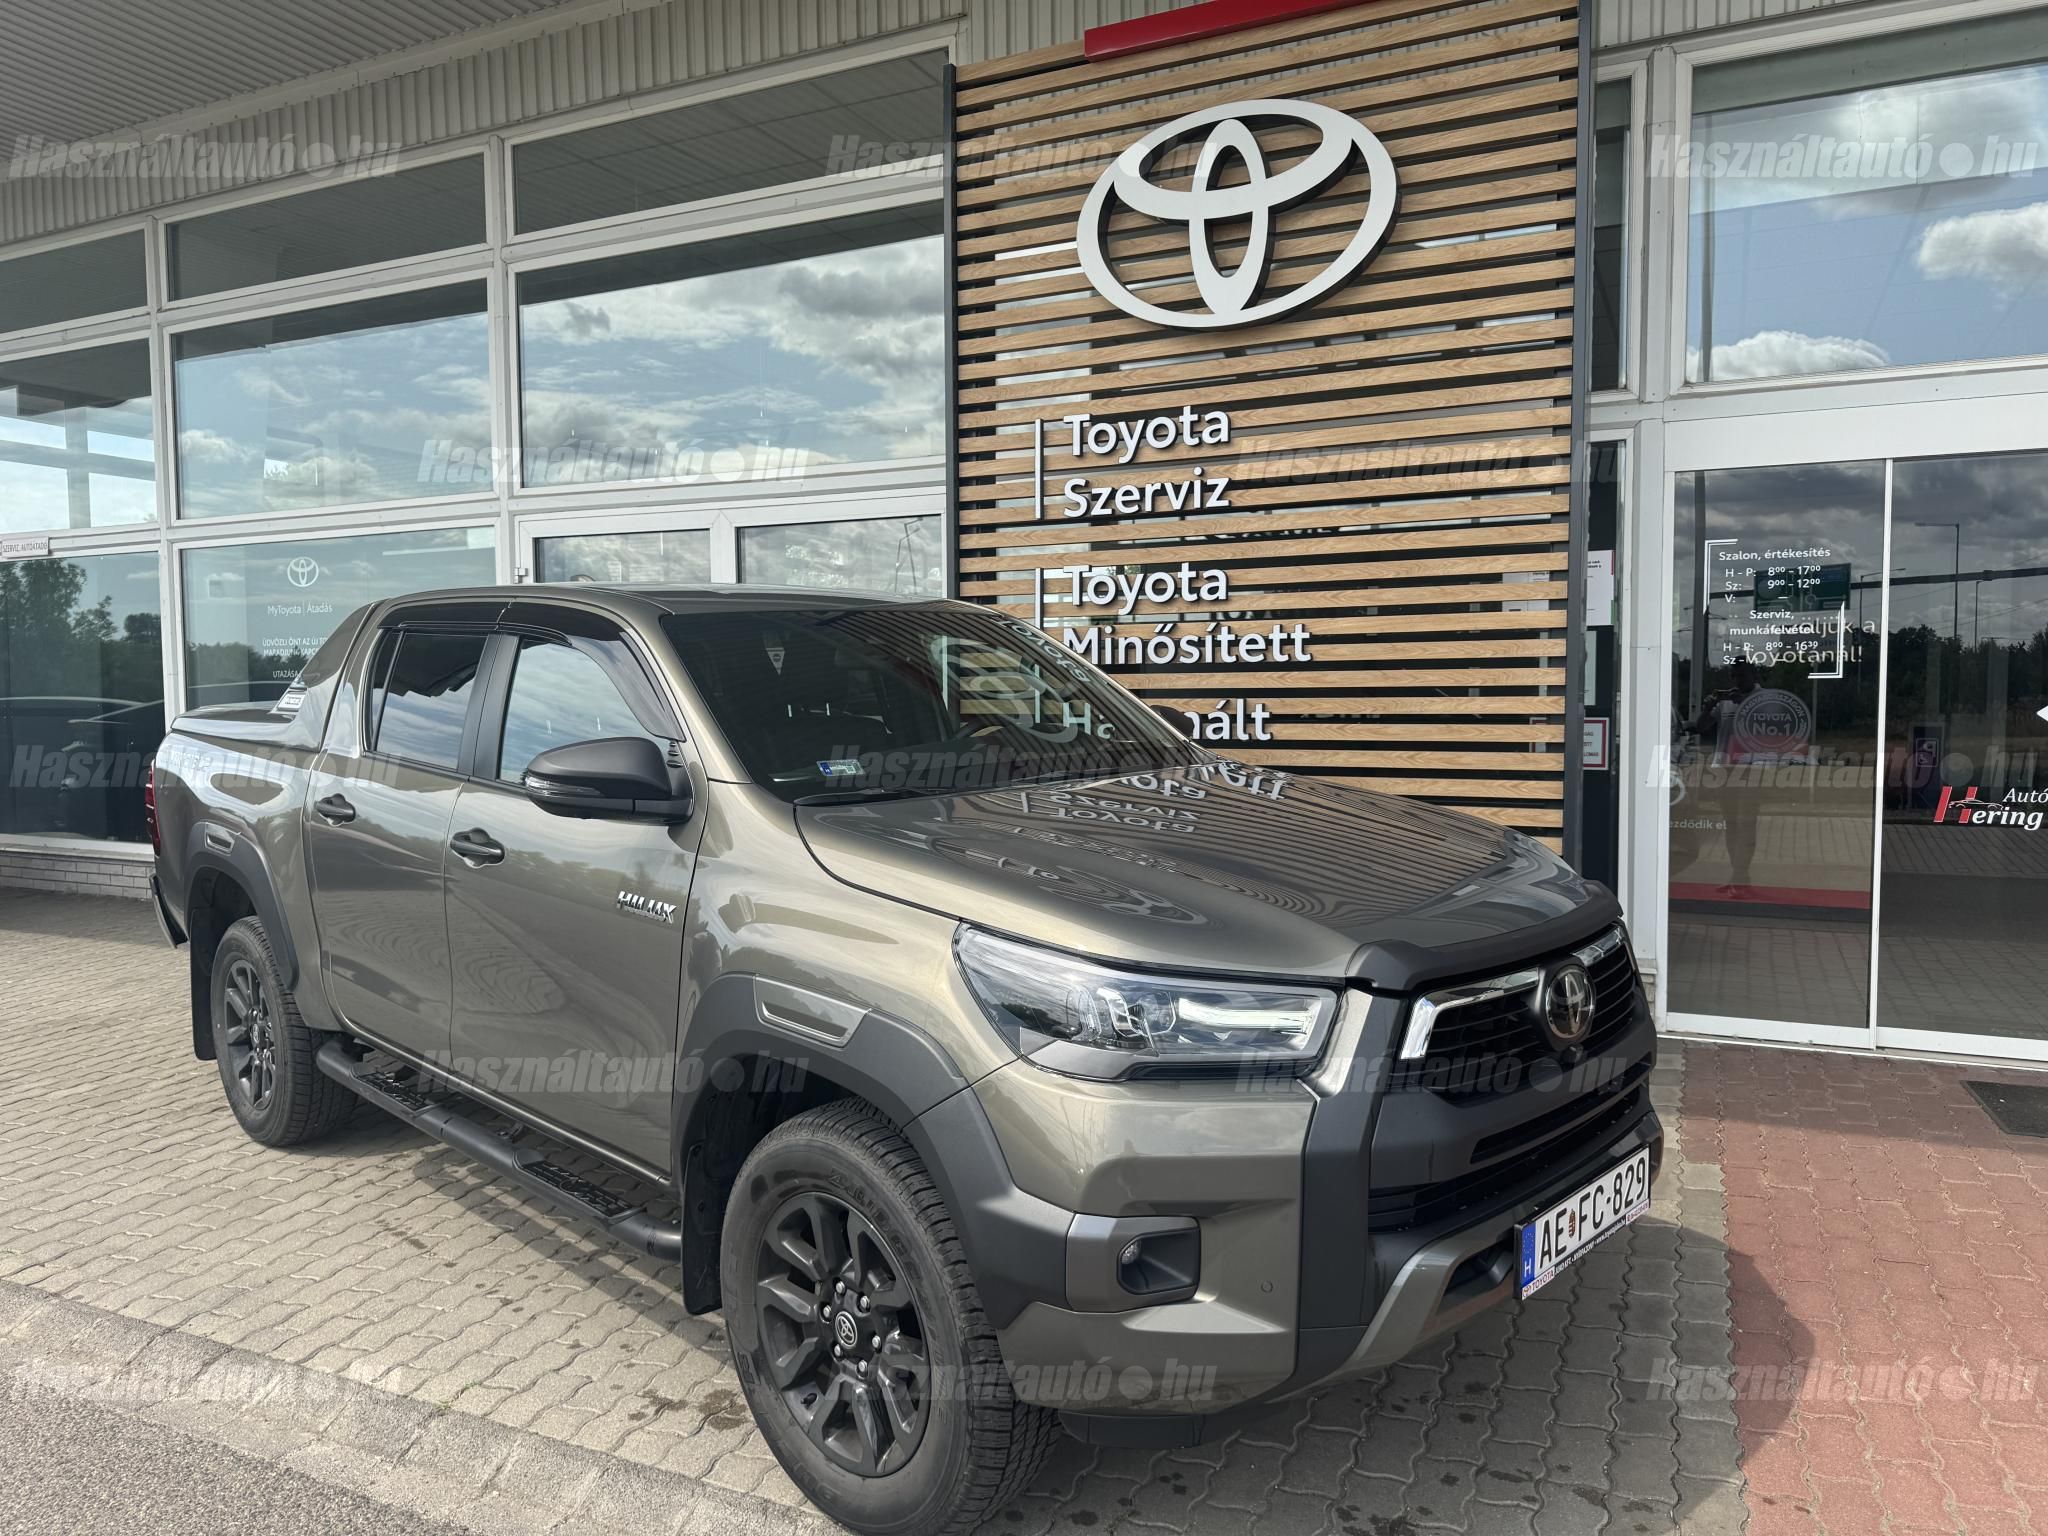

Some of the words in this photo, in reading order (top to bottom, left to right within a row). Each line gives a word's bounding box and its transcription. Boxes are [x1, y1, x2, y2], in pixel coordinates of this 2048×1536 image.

[1063, 405, 1231, 464] Toyota
[1063, 467, 1231, 518] Szerviz
[1719, 551, 1761, 561] Szalon,
[1764, 547, 1831, 559] értékesítés
[1063, 562, 1229, 616] Toyota
[267, 605, 302, 617] MyToyota
[1749, 608, 1795, 620] Szerviz,
[1062, 623, 1313, 665] Minősített
[1753, 712, 1792, 721] TOYOTA
[1933, 786, 2043, 831] Hering
[1539, 1207, 1568, 1269] AE
[1524, 1258, 1532, 1278] H
[1532, 1268, 1555, 1290] TOYOTA
